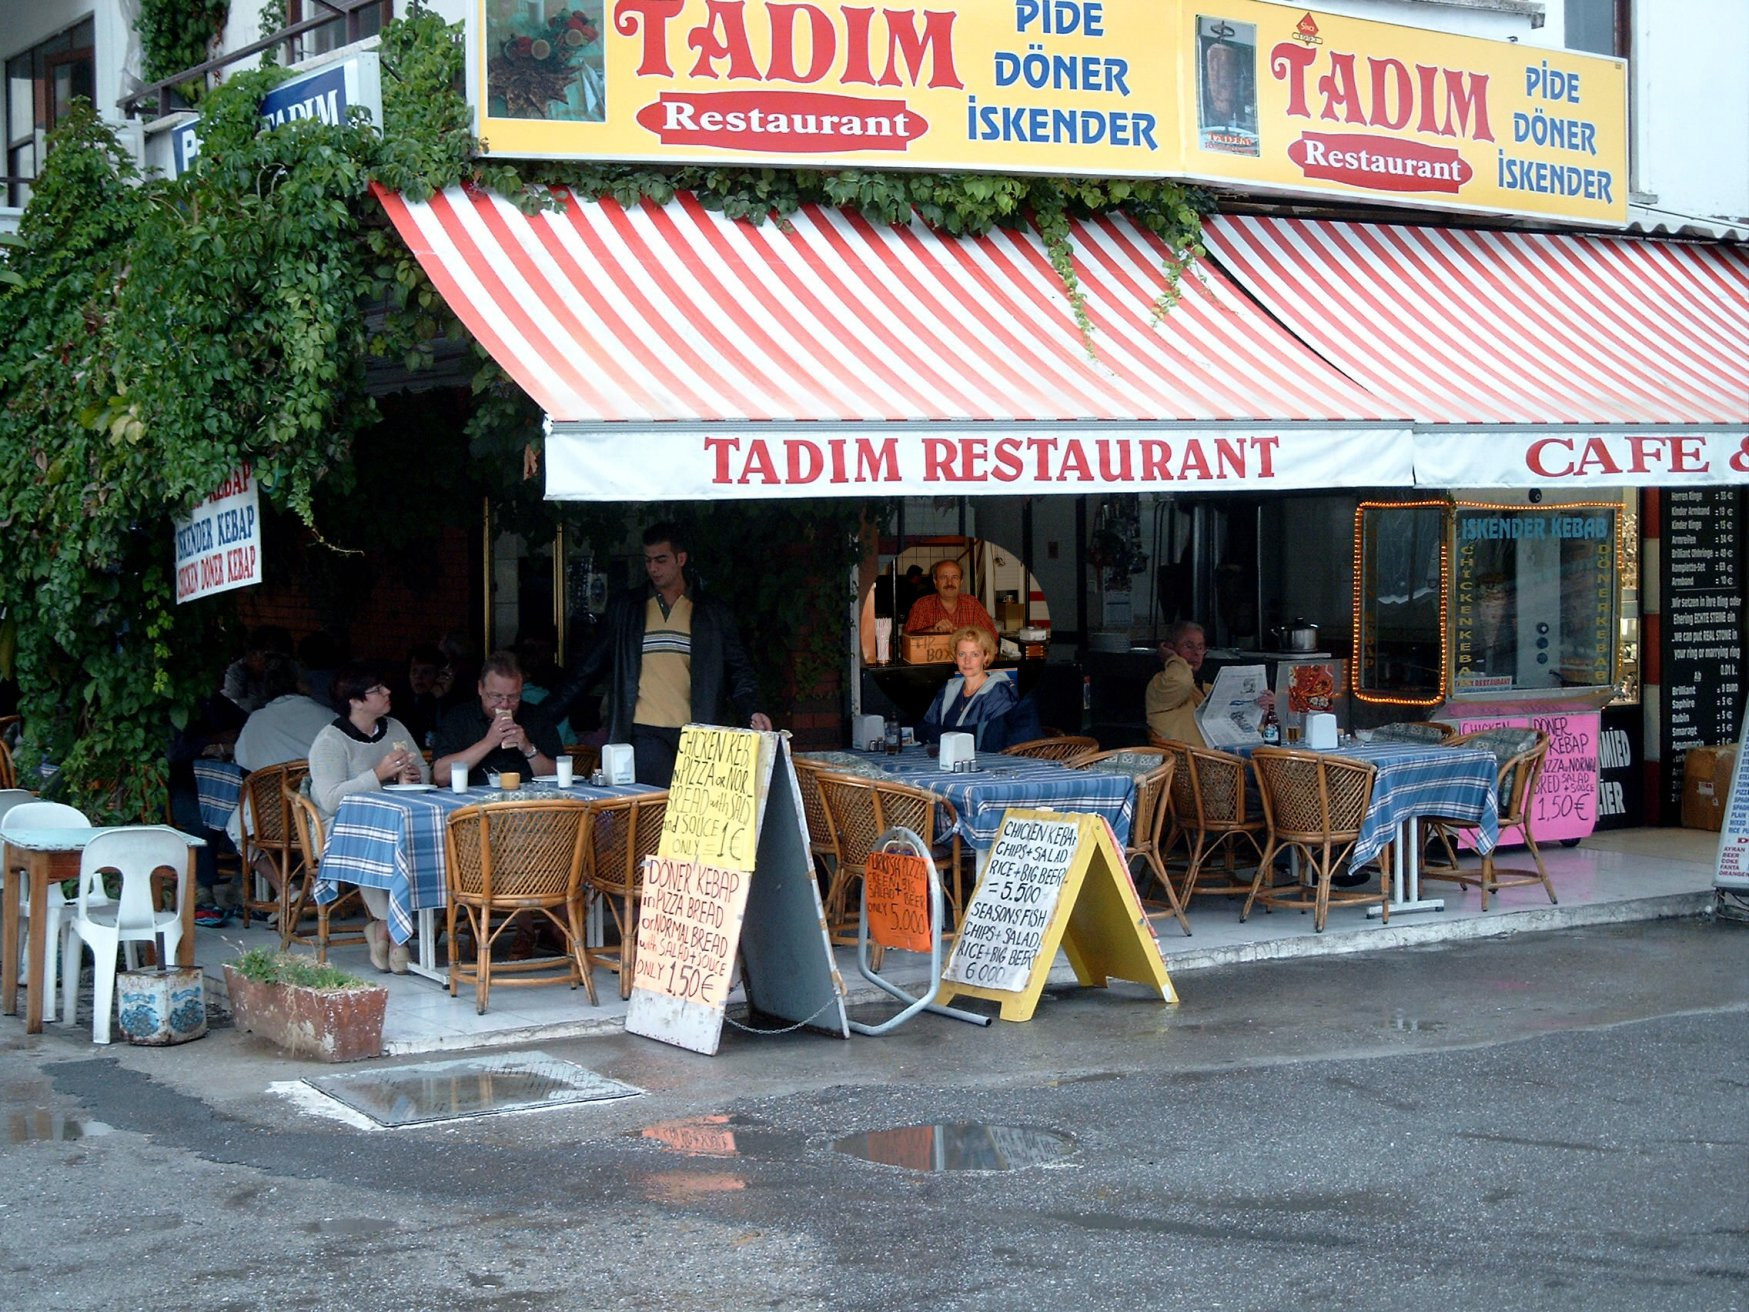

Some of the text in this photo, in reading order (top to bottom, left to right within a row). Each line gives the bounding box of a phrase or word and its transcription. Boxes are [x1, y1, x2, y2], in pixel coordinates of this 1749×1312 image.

[615, 0, 964, 90] TADIM
[995, 45, 1130, 96] DÖNER
[1271, 43, 1495, 142] TADIM
[662, 102, 908, 138] Restaurant
[968, 95, 1158, 151] İSKENDER
[1514, 109, 1596, 155] DÖNER
[1305, 142, 1461, 182] Restaurant
[1499, 149, 1612, 204] İSKENDER
[704, 436, 1279, 484] TADIM RESTAURANT
[1525, 436, 1709, 476] CAFE
[217, 505, 255, 546] KEBAP
[227, 545, 256, 583] KEBAP
[927, 648, 950, 662] BOX
[679, 731, 727, 762] CHICKEN
[1549, 733, 1590, 755] KEBAP
[680, 756, 714, 786] PIZZA
[996, 842, 1027, 860] CHIPS
[1032, 846, 1068, 863] SALAD
[697, 865, 739, 902] KEBAP
[989, 860, 1016, 877] RICE
[1038, 868, 1066, 887] BEER
[643, 889, 724, 928] in PIZZA BREAD
[1000, 882, 1042, 904] 5.500
[964, 921, 996, 942] CHIPS
[971, 902, 1048, 928] SEASONS FISH
[654, 914, 688, 944] NORMAL
[690, 926, 728, 958] BREAD
[659, 938, 689, 962] SALAD
[637, 960, 664, 980] ONLY
[957, 940, 985, 960] RICE
[1008, 949, 1038, 970] BEER
